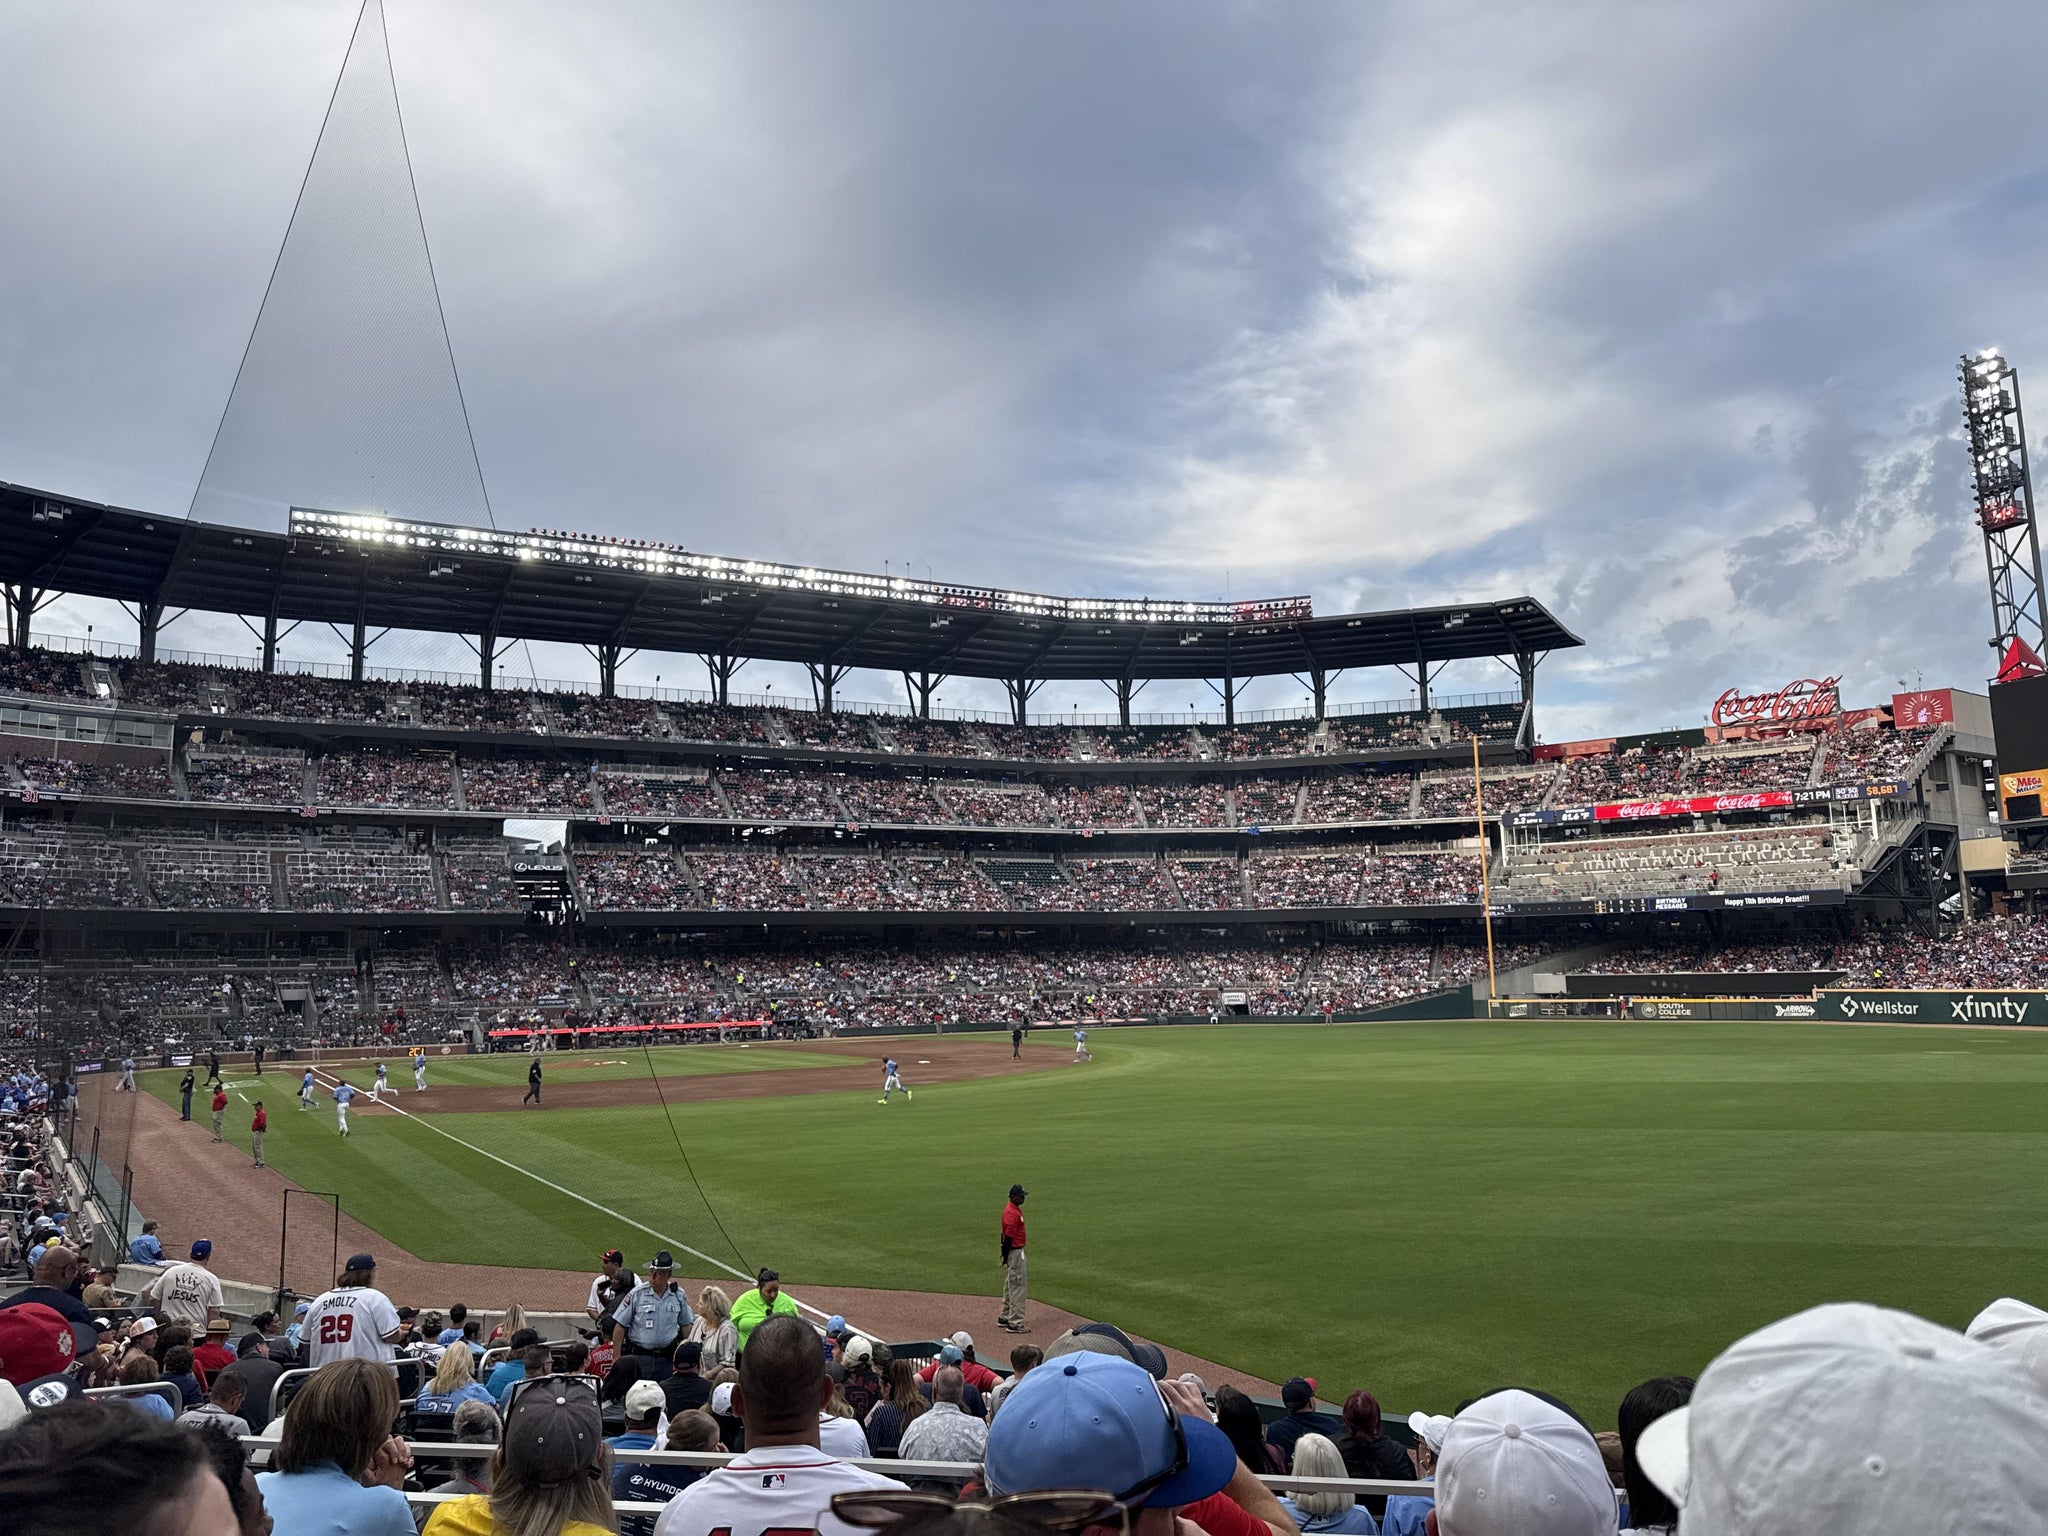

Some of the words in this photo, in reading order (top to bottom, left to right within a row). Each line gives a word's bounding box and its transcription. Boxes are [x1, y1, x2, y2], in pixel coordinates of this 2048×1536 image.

[1712, 675, 1843, 727] Coca-Cola
[2017, 777, 2042, 787] MEGA
[22, 789, 39, 803] 31
[1794, 792, 1814, 802] 7:21
[1816, 790, 1831, 800] PM
[300, 806, 318, 817] 35
[1561, 813, 1579, 821] 81.6
[1724, 898, 1744, 907] Happy
[1757, 896, 1784, 905] Birthday
[1785, 895, 1810, 903] Grant!!!
[1785, 1005, 1810, 1013] ARROW
[1860, 1000, 1919, 1015] Wellstar
[1950, 995, 2029, 1023] xfinity
[168, 1290, 201, 1303] JESUS
[323, 1296, 358, 1311] SMOLTZ
[320, 1313, 354, 1345] 29
[643, 1478, 685, 1496] HYUNDA
